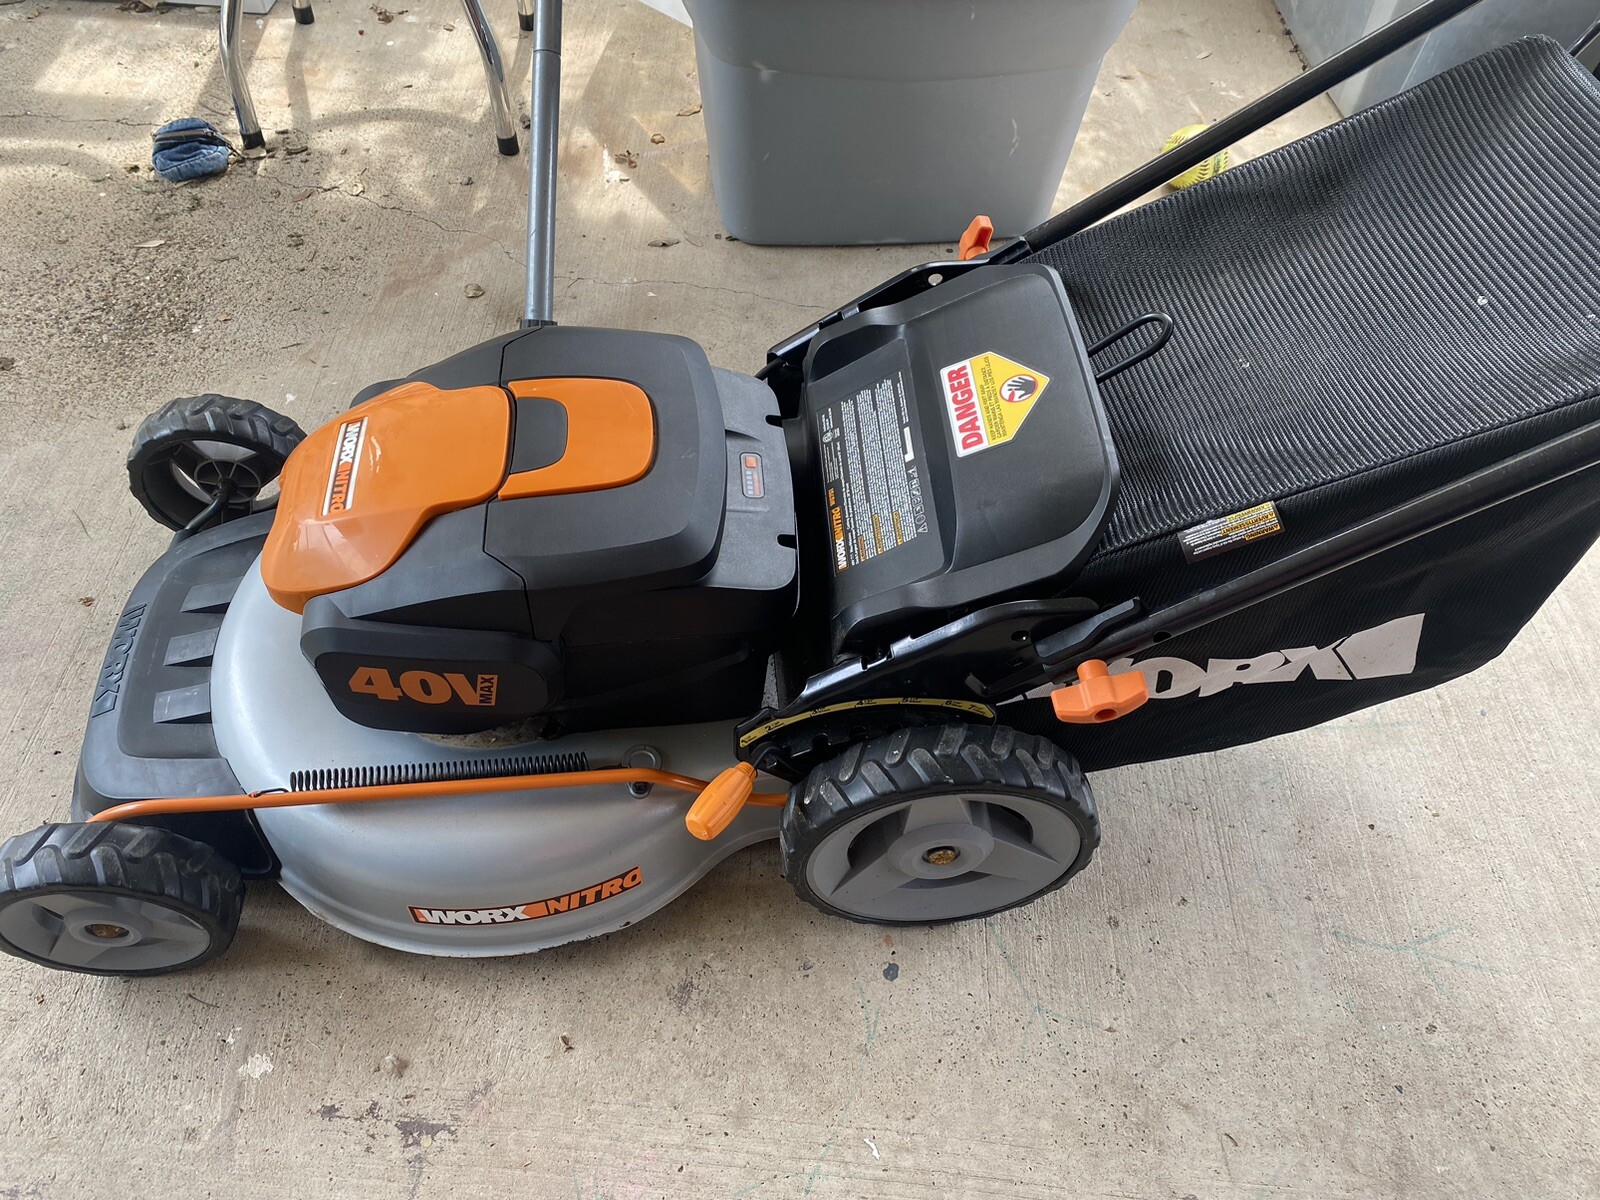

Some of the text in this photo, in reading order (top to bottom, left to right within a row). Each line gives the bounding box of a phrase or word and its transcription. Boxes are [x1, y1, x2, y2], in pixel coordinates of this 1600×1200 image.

[980, 367, 989, 385] DISTANCE
[946, 364, 984, 450] DANGER
[991, 388, 999, 403] MANOS
[992, 420, 1001, 438] GARDER
[996, 412, 1007, 437] MANTENGA
[329, 421, 361, 514] WORX NITRO
[831, 505, 843, 535] NITRO
[1221, 514, 1269, 534] AVERTISSEMENT
[1245, 525, 1274, 539] WARNING
[835, 536, 848, 569] WORX
[97, 603, 147, 702] WORX
[348, 666, 499, 706] 40V
[479, 675, 495, 704] MAX
[418, 865, 643, 925] WORX NITRO
